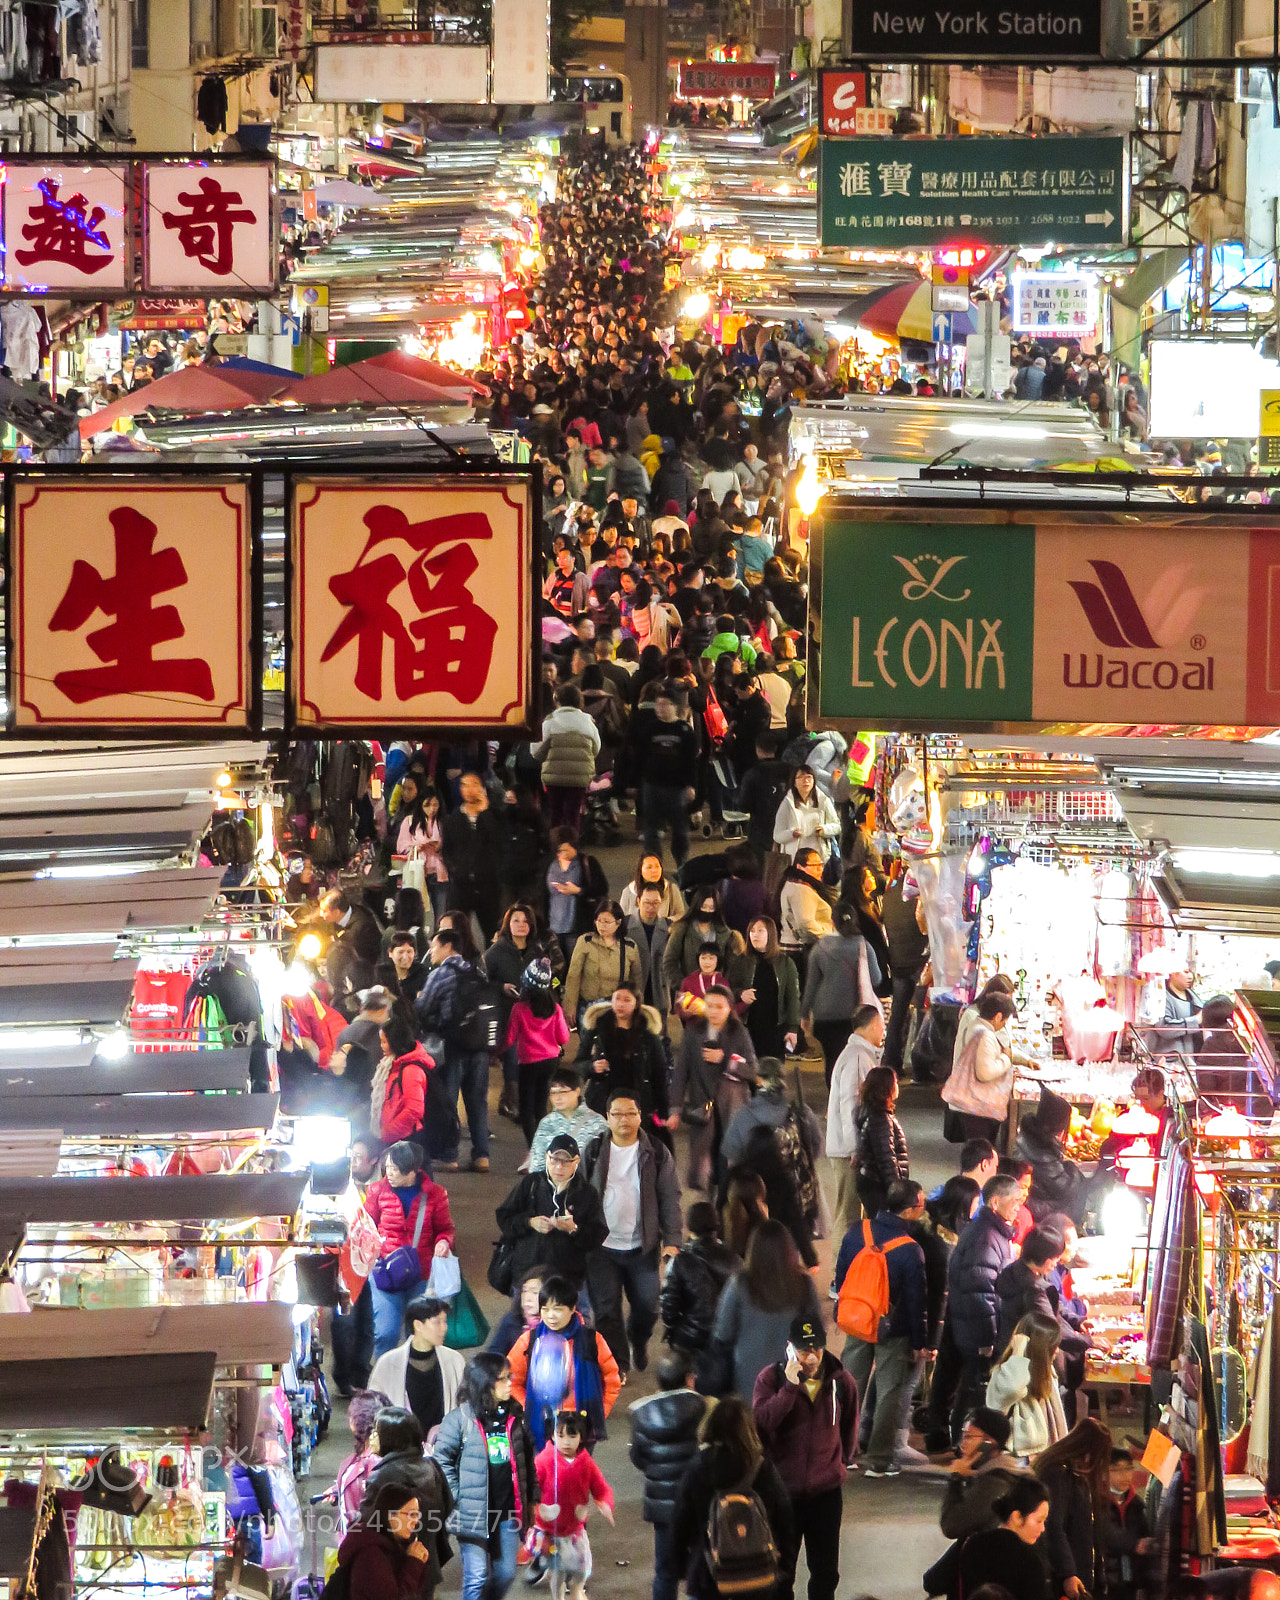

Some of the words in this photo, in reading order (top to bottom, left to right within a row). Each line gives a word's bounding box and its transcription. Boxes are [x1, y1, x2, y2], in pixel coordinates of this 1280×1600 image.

[872, 11, 925, 34] New
[935, 11, 989, 34] York
[998, 11, 1082, 34] Station
[920, 190, 960, 198] Solutions
[962, 189, 989, 197] Health
[991, 189, 1011, 197] Care
[1013, 188, 1050, 197] Products
[1062, 188, 1096, 196] Services
[921, 169, 1115, 190] 醫療用品配套有限公司
[162, 176, 257, 275] 奇
[47, 506, 216, 704] 生
[320, 504, 499, 704] 福
[852, 616, 1006, 690] LEONA
[1063, 653, 1215, 691] Wacoal
